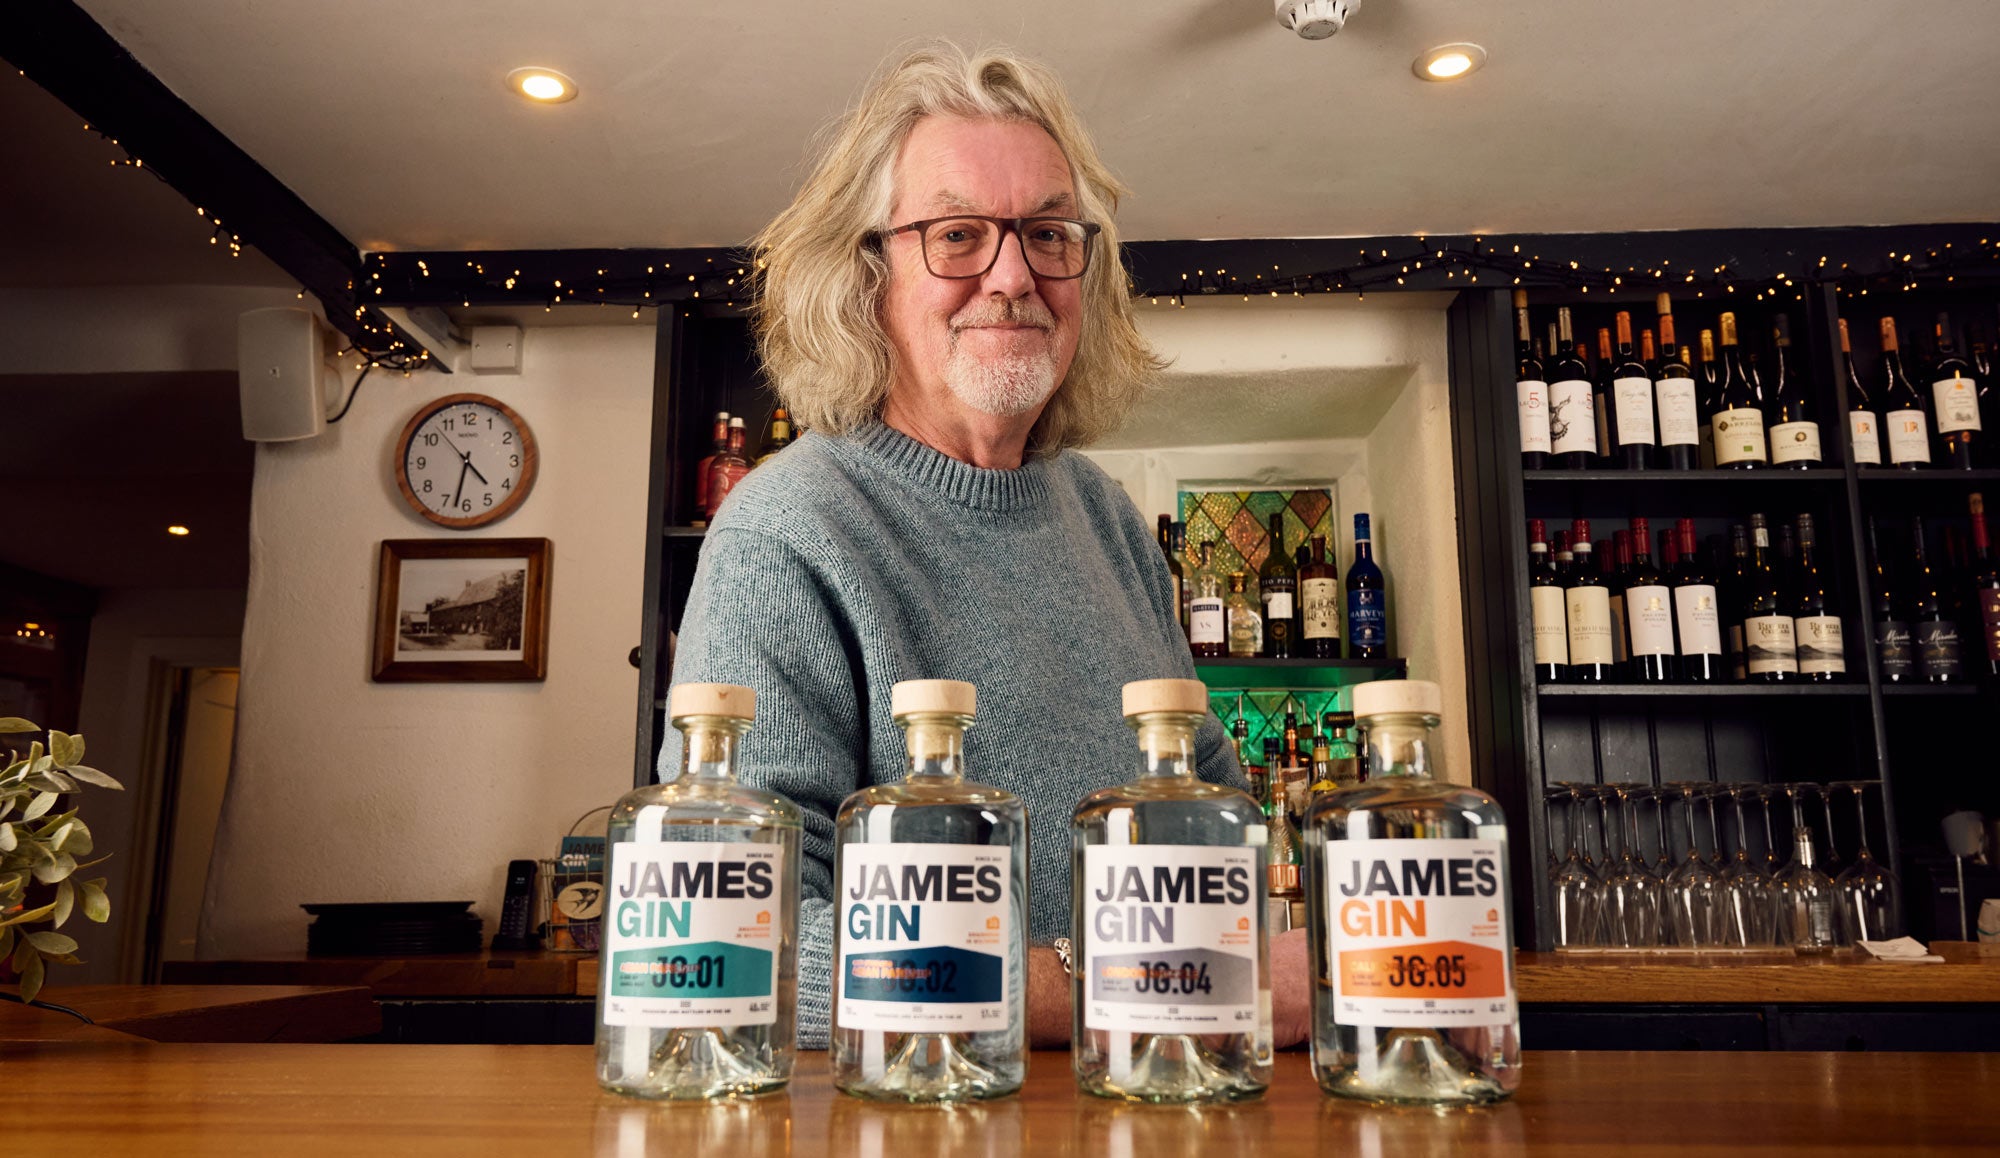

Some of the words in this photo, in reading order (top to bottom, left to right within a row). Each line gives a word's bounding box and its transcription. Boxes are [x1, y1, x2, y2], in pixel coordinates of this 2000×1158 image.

[442, 419, 454, 431] 11
[462, 413, 477, 426] 12
[486, 418, 493, 430] 1
[423, 433, 439, 446] 10
[502, 431, 513, 445] 2
[416, 456, 426, 470] 9
[509, 454, 519, 468] 3
[423, 479, 433, 493] 8
[501, 478, 511, 490] 4
[441, 494, 450, 507] 7
[461, 499, 472, 512] 6
[483, 493, 493, 506] 5
[565, 843, 605, 854] JAME
[561, 854, 590, 867] GIN
[619, 861, 774, 899] JAMES
[850, 865, 1001, 903] JAMES
[1340, 858, 1497, 897] JAMES
[1095, 866, 1250, 904] JAMES
[617, 901, 691, 938] GIN
[848, 903, 920, 941] GIN
[1094, 905, 1174, 943] GIN
[1340, 900, 1427, 937] GIN
[652, 956, 725, 989] JG.01
[1135, 961, 1212, 995] JG.04
[1389, 955, 1466, 988] JG.05
